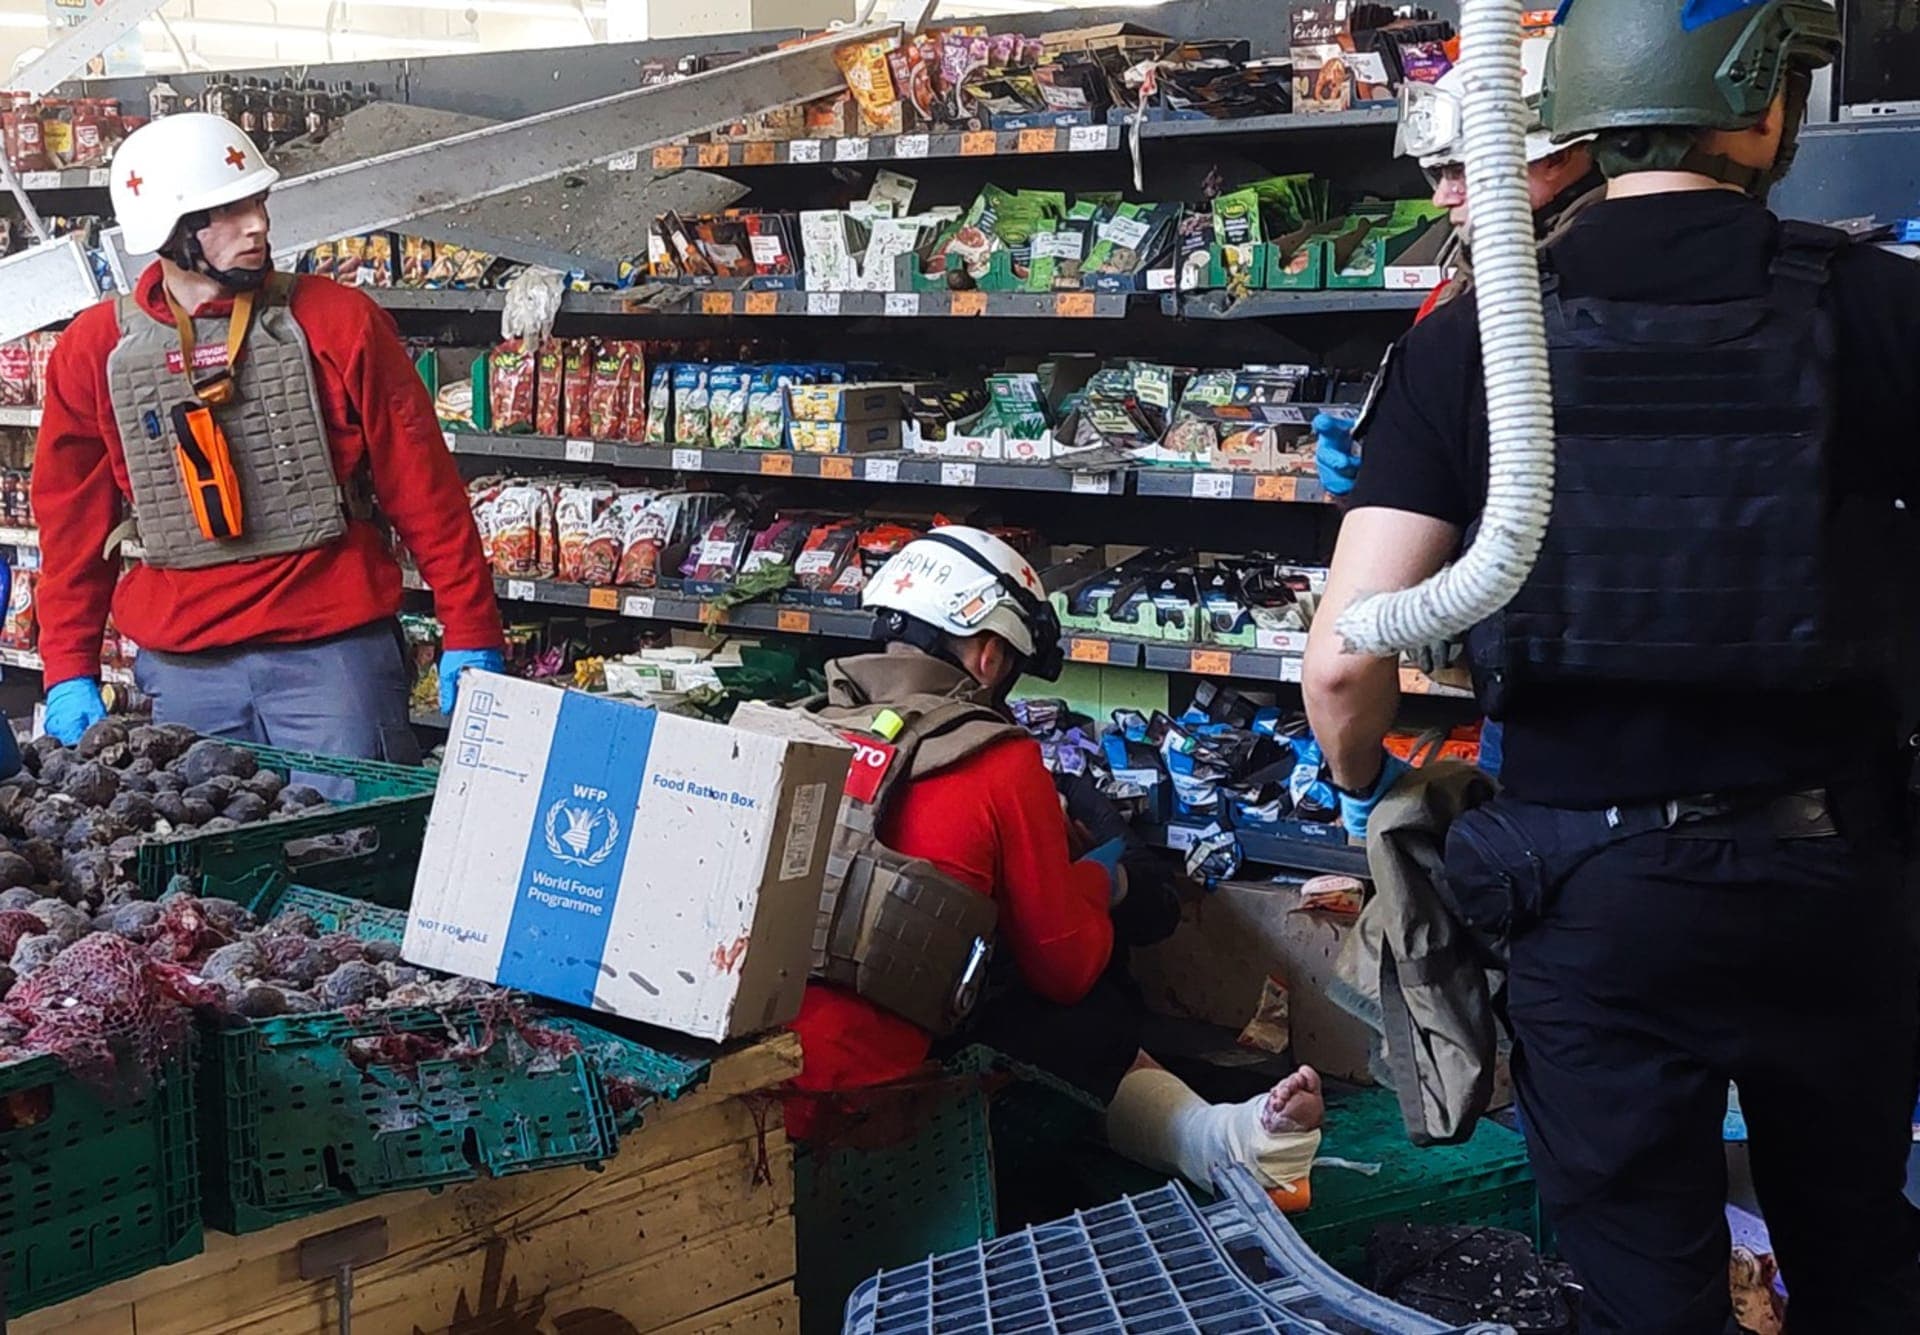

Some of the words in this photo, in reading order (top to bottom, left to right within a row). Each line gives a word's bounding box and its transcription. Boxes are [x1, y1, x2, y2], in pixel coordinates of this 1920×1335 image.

[573, 783, 608, 803] WFP
[653, 774, 685, 791] Food
[686, 782, 728, 802] Ration
[730, 792, 756, 808] Box
[533, 870, 571, 891] World
[571, 880, 604, 899] Food
[527, 886, 603, 916] Programme
[418, 918, 440, 931] NOT
[442, 924, 462, 936] FOR
